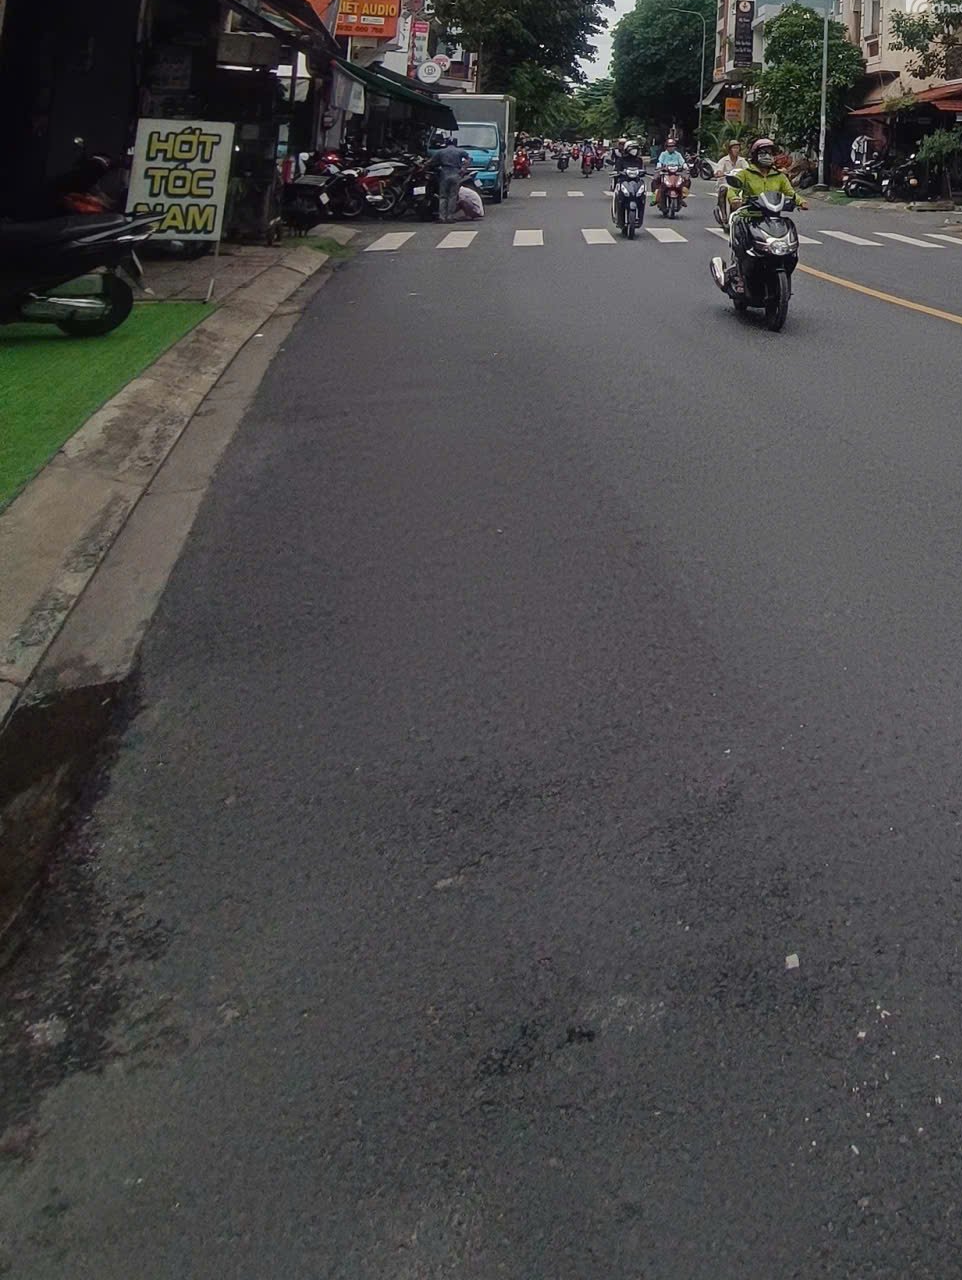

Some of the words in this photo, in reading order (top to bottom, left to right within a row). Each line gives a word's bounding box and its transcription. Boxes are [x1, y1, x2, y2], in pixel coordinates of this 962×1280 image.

[362, 4, 397, 17] AUDIO
[146, 126, 221, 163] HỚT
[144, 162, 216, 198] TÓC
